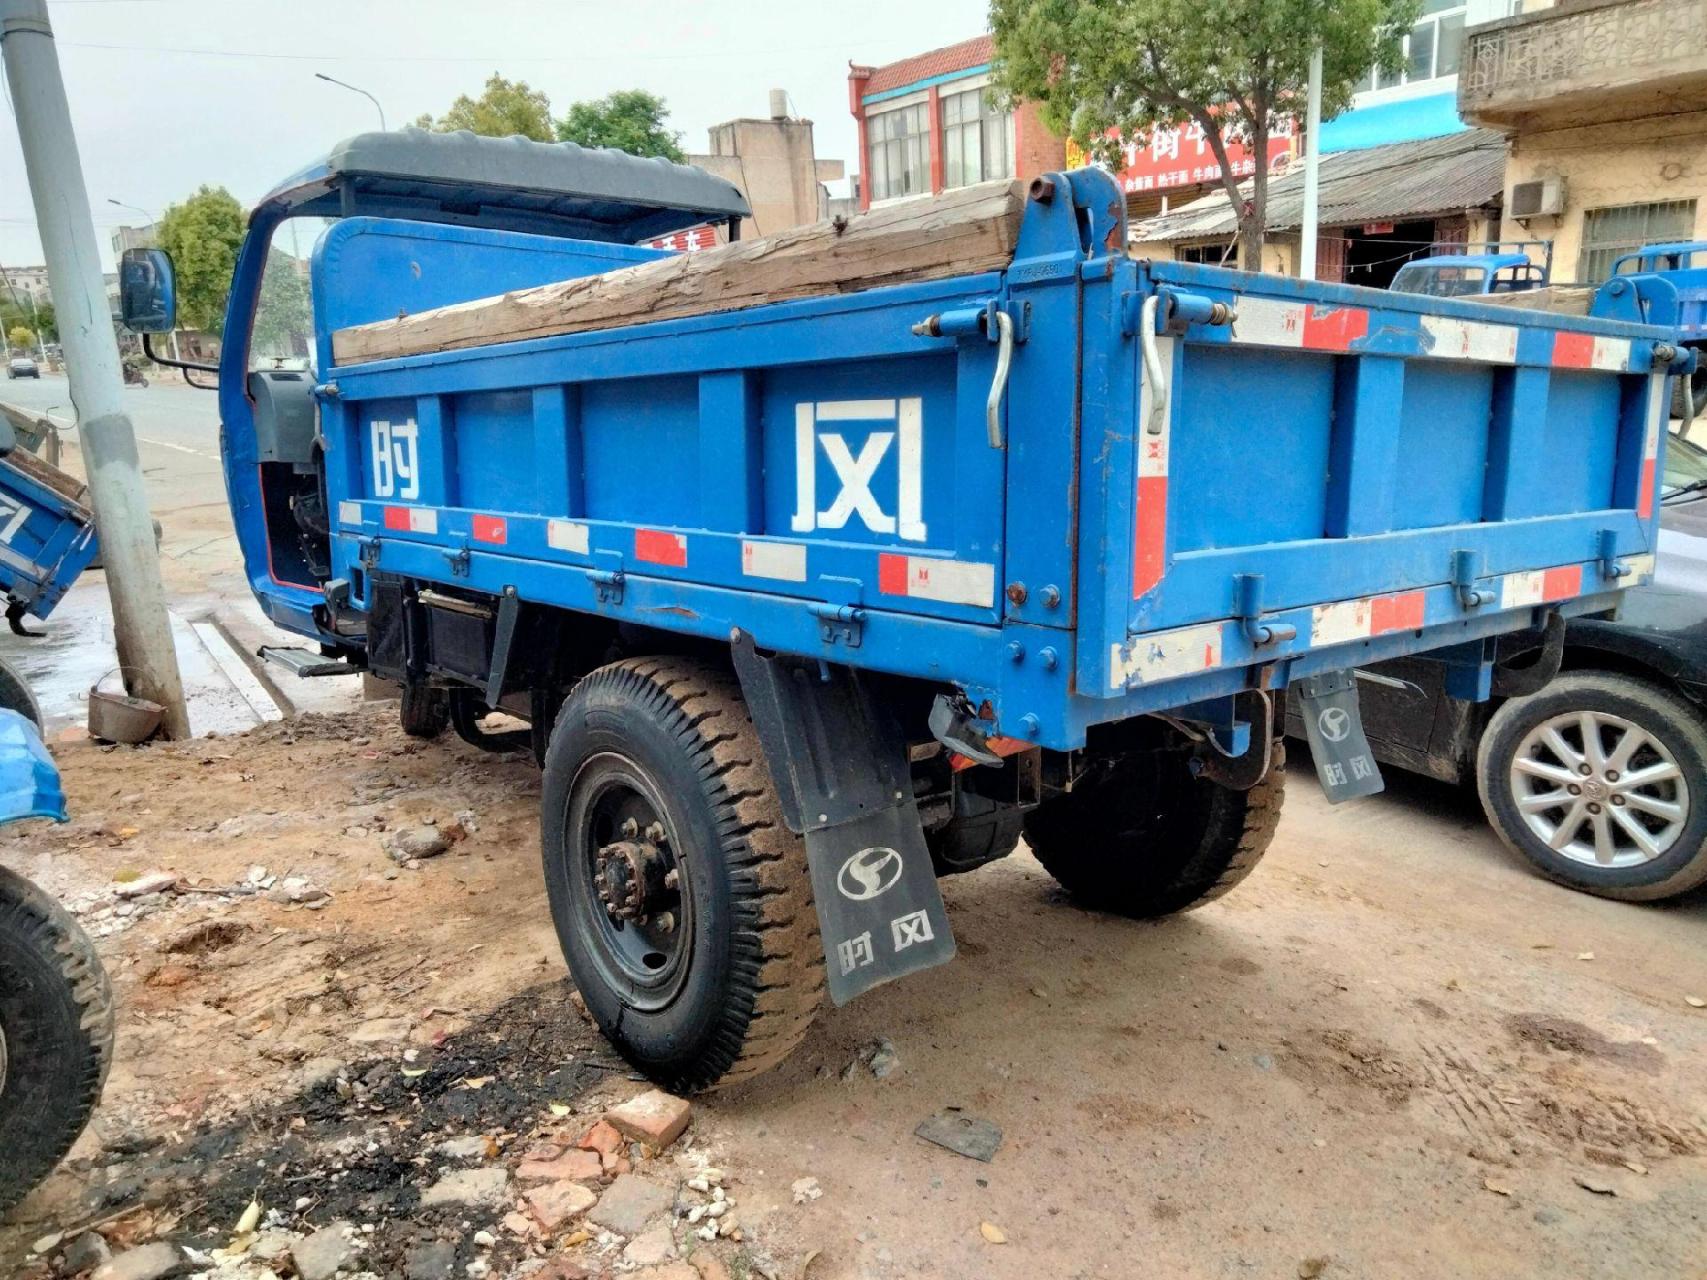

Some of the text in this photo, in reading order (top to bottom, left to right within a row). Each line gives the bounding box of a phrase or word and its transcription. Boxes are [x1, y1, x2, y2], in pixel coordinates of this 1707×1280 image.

[371, 398, 927, 542] 时 风
[837, 909, 935, 976] 时风
